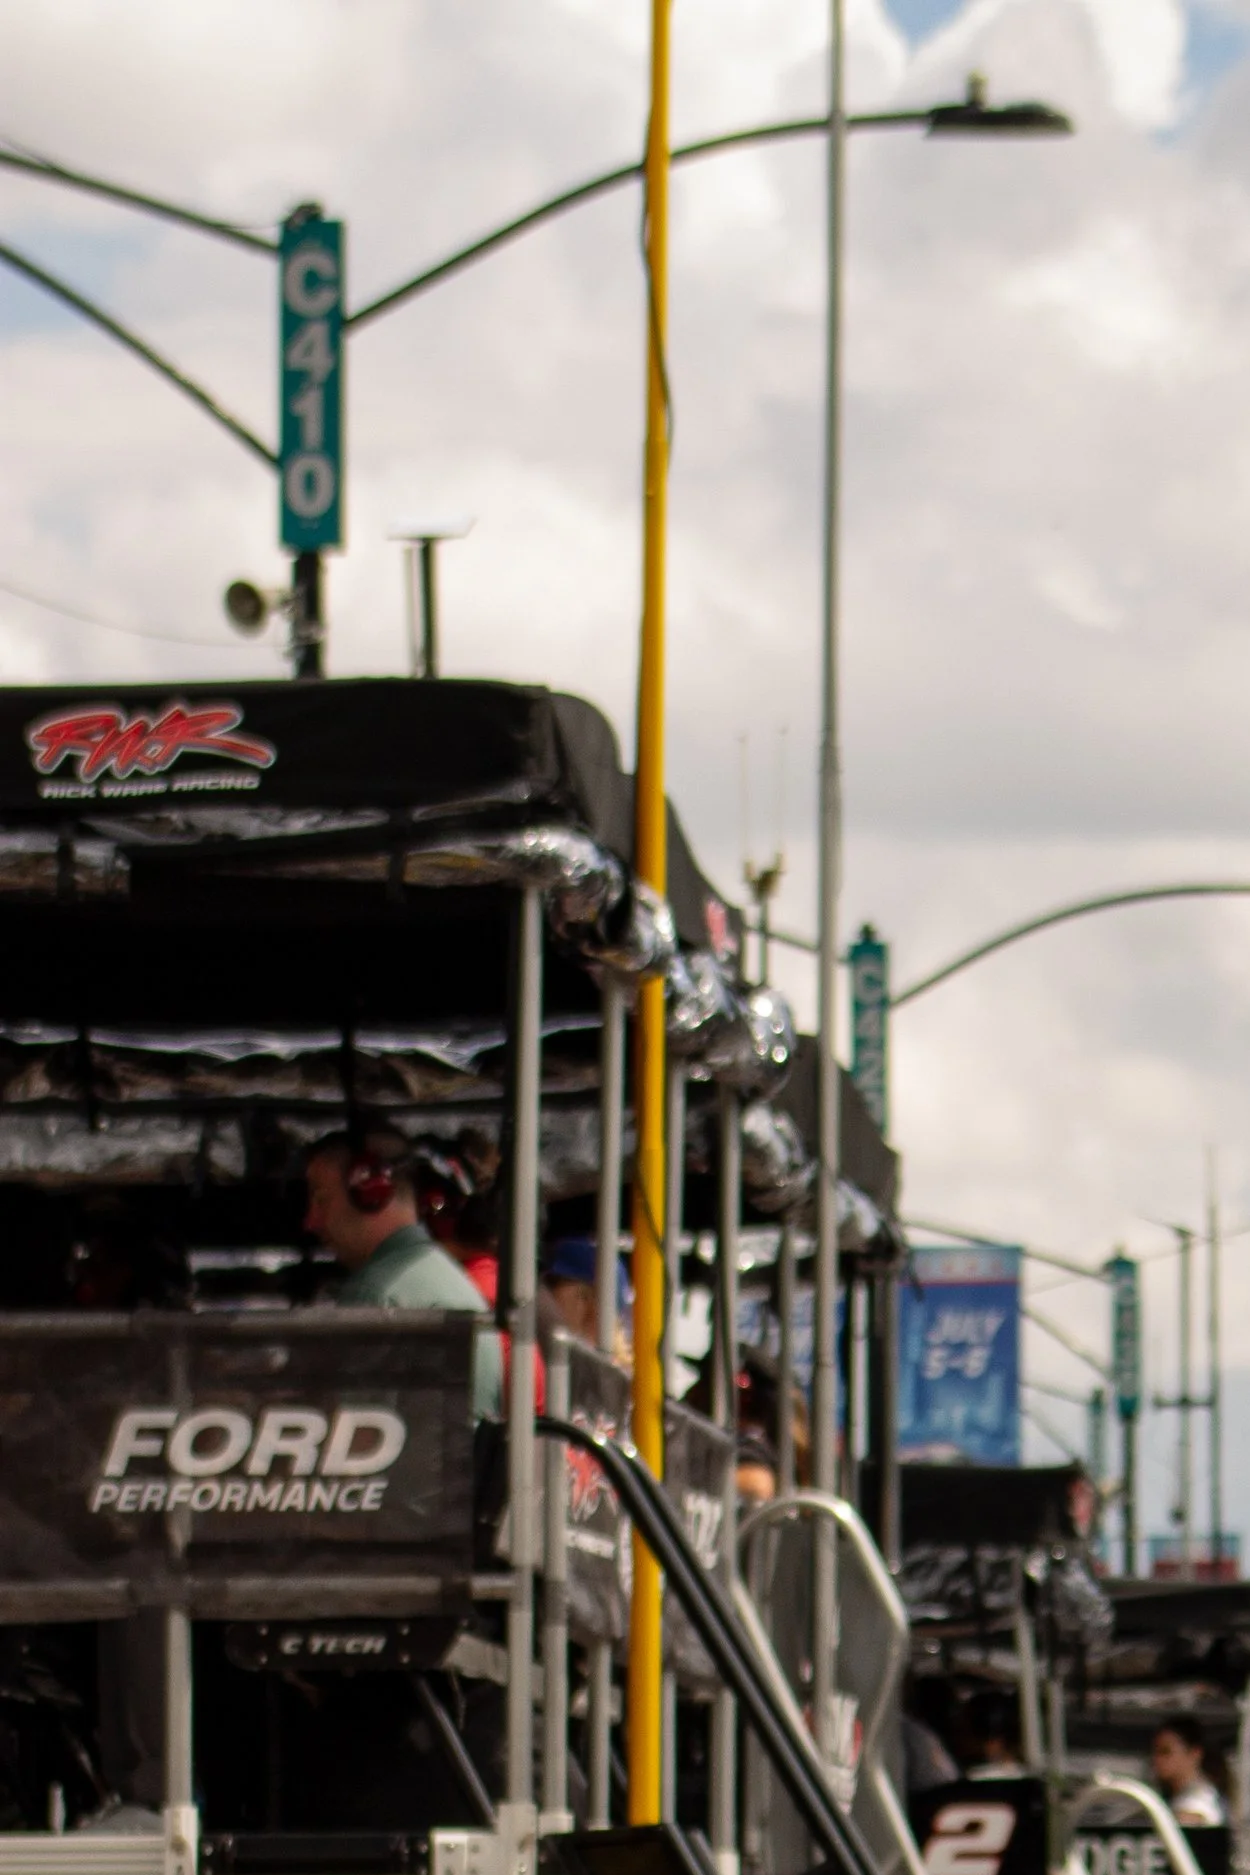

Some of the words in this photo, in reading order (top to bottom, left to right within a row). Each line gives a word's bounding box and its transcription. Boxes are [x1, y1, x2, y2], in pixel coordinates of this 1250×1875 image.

[284, 248, 338, 519] C410
[103, 1406, 407, 1479] FORD
[87, 1479, 389, 1514] PERFORMANCE
